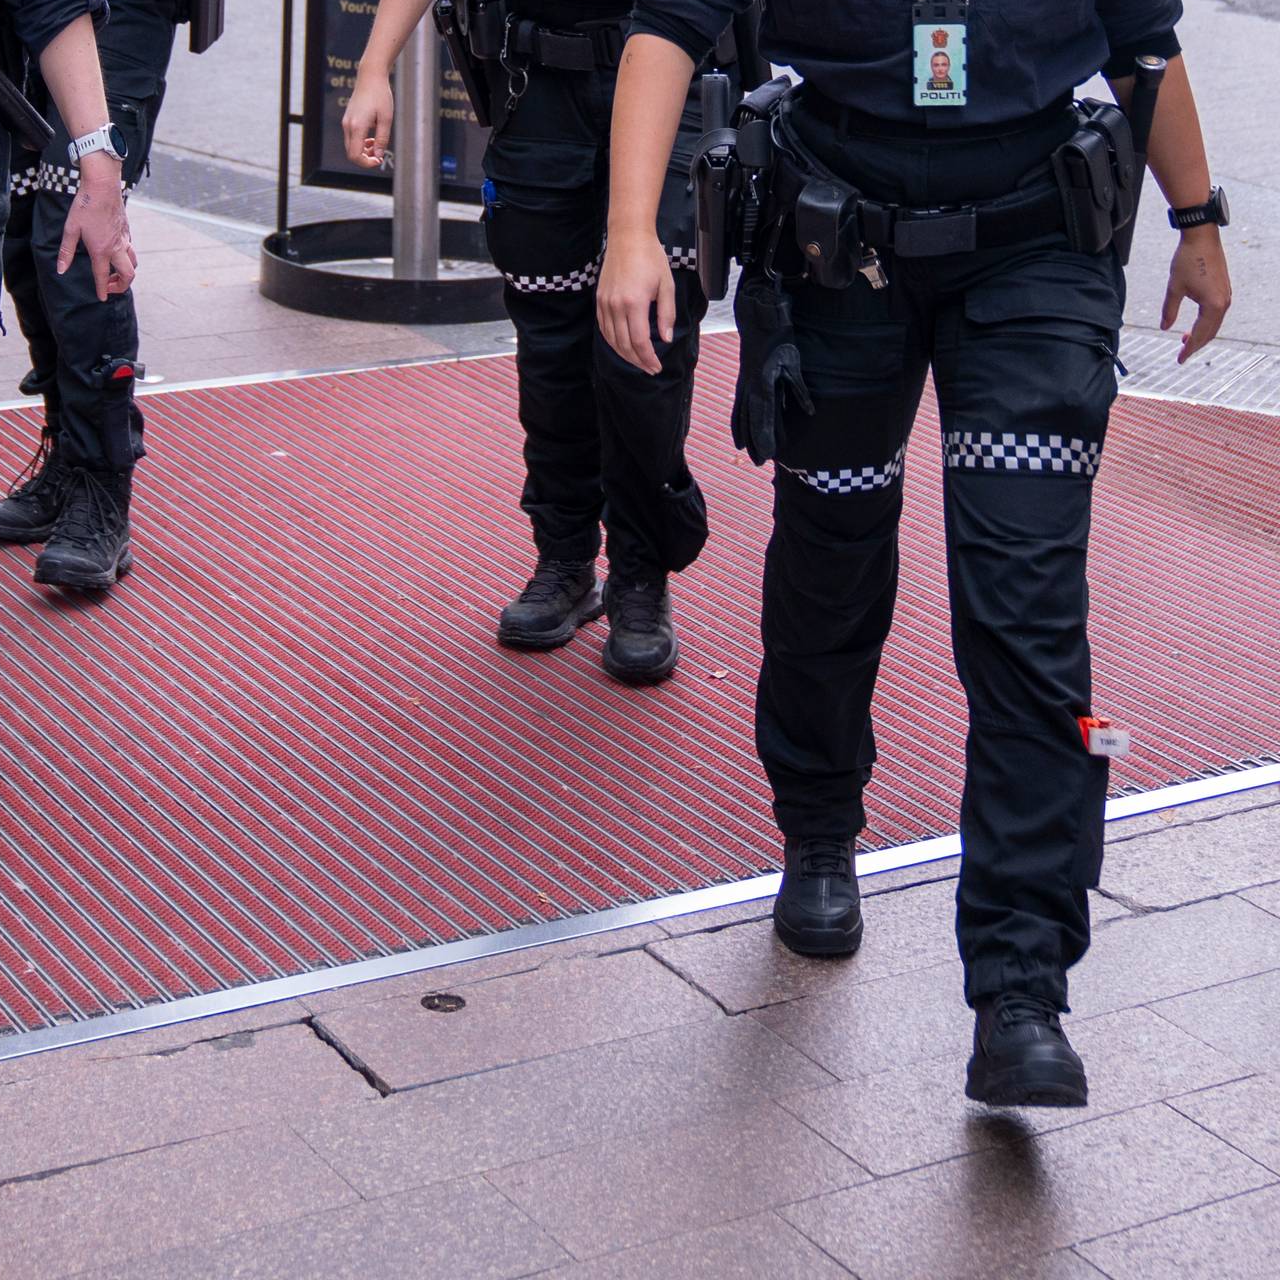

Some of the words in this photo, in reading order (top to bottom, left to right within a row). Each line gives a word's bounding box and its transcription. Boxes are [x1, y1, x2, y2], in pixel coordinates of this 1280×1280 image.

[327, 55, 352, 70] You
[330, 75, 346, 88] of
[920, 92, 961, 100] POLITI
[440, 108, 467, 121] ront
